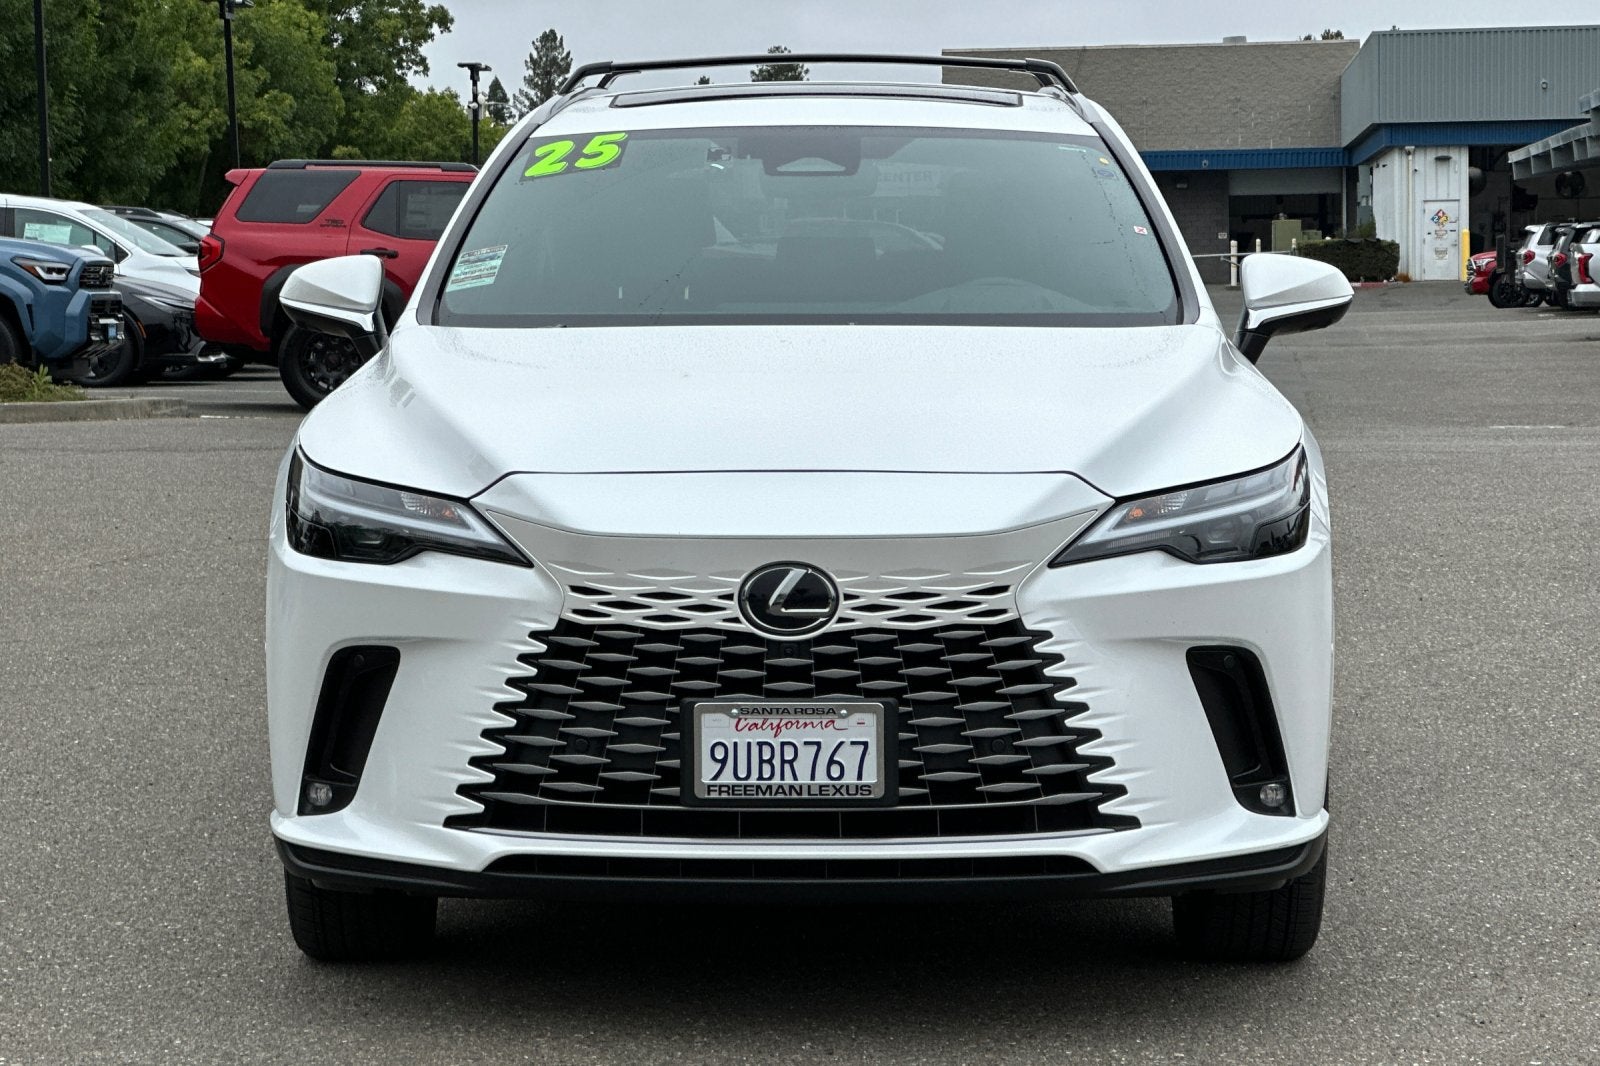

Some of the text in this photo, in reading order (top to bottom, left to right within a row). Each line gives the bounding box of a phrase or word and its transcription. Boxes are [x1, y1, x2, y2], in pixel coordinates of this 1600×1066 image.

[524, 132, 628, 177] 25
[740, 707, 837, 715] SANTA ROSA
[735, 718, 848, 738] California
[709, 741, 869, 781] 9UBR767
[707, 784, 872, 796] FREEMAN LEXUS
